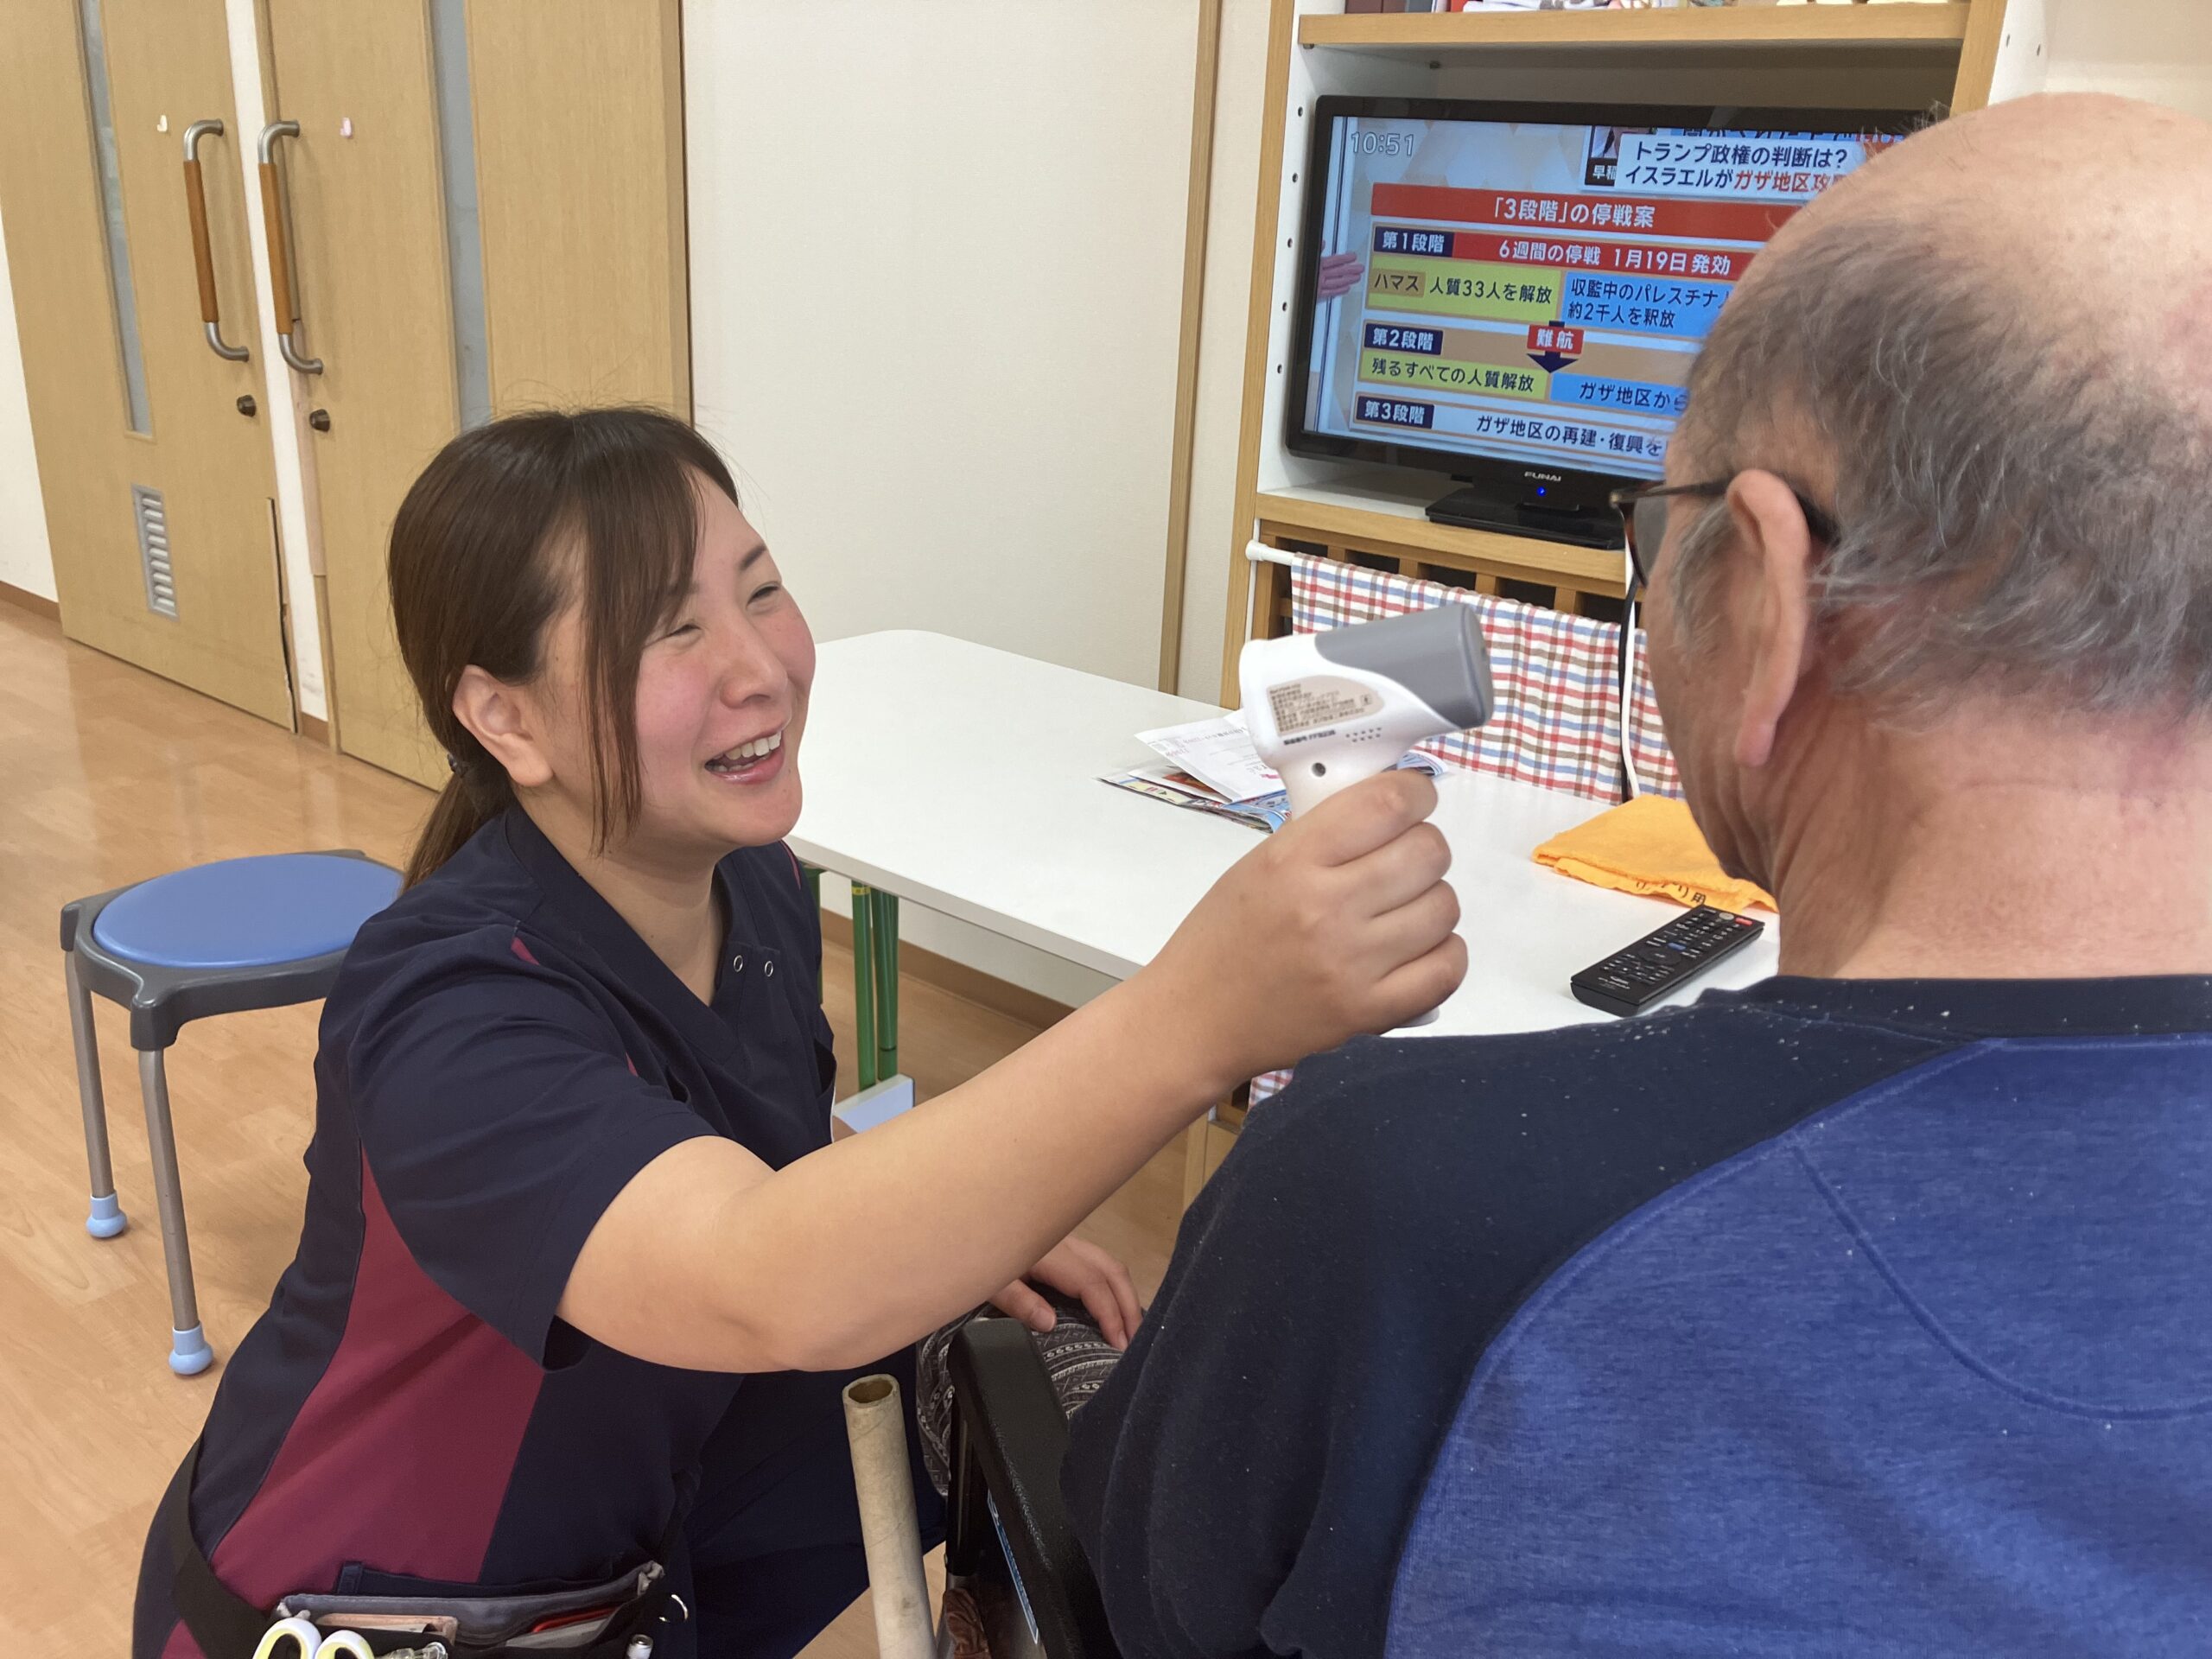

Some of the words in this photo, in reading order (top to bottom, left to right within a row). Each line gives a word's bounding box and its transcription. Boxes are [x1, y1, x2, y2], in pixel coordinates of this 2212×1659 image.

[1351, 131, 1414, 156] 10:51
[1625, 165, 1846, 193] イスラエルがガザ地区攻
[1494, 197, 1655, 227] 「3段階」の停戦案
[1382, 231, 1445, 253] 第1段階
[1499, 239, 1602, 265] 6週間の停戦
[1374, 273, 1419, 292] ハマス
[1429, 276, 1553, 304] 人質33人を解放
[1567, 301, 1676, 329] 約2千人を釈放
[1372, 327, 1434, 352] 第2段階
[1372, 358, 1535, 393] 残るすべての人質解放
[1363, 400, 1425, 425] 第3段階
[1476, 415, 1669, 457] ガザ地区の再建・復興を
[1524, 471, 1561, 482] FUNAI
